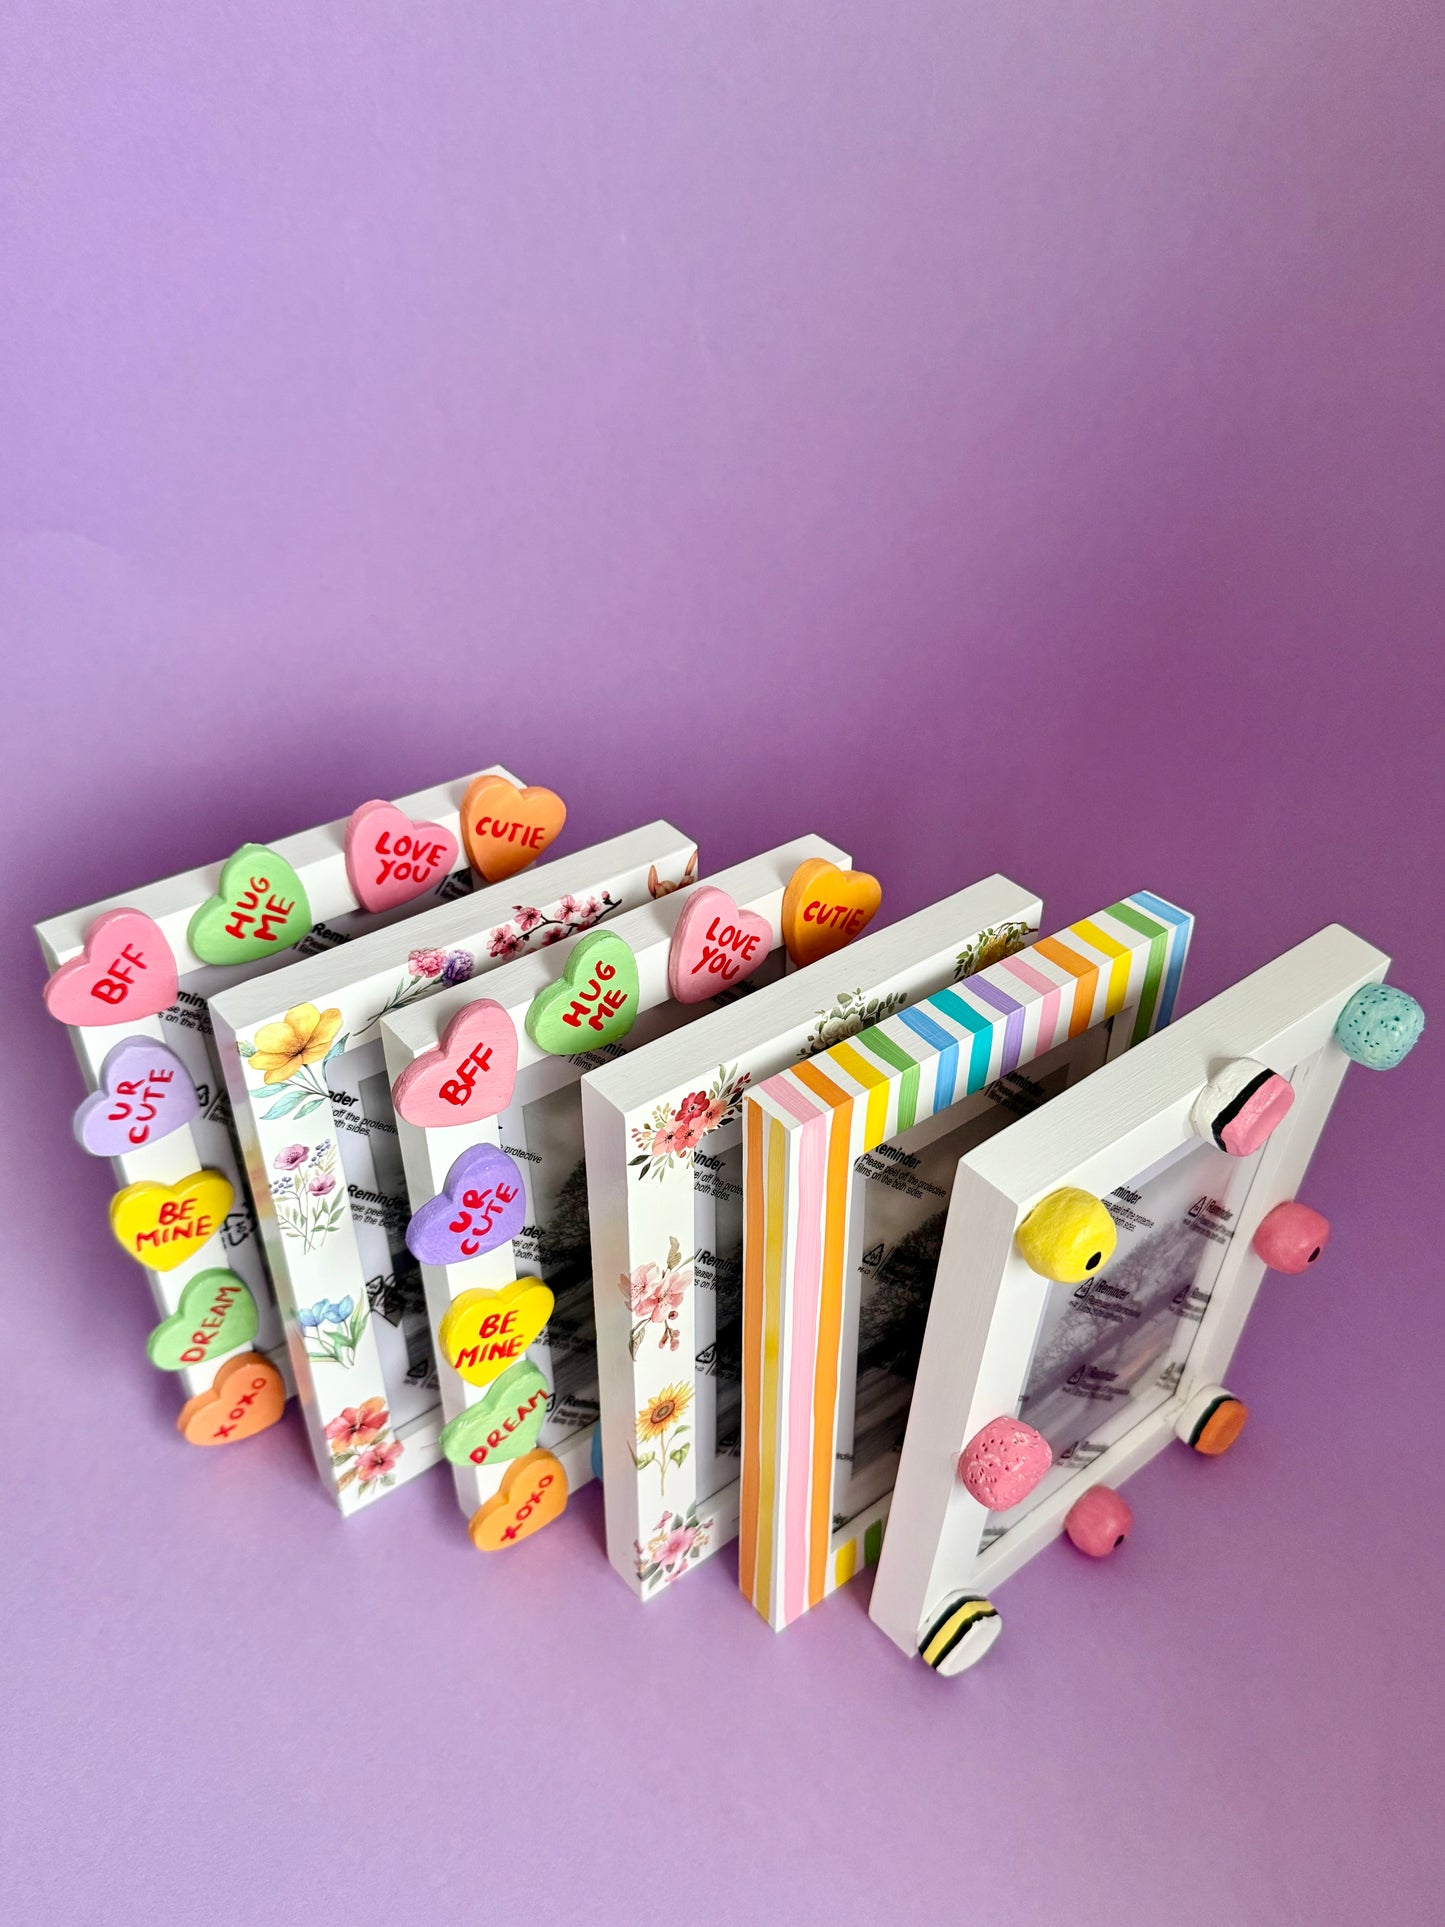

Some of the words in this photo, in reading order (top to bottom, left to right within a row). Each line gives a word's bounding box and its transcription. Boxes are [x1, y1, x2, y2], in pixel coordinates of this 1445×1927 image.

[375, 831, 448, 868] LOVE
[476, 817, 546, 850] CUTIE
[376, 858, 431, 886] YOU
[225, 875, 270, 939] HUG
[253, 894, 296, 941] ME
[803, 901, 866, 935] CUTIE
[706, 917, 761, 962] LOVE
[90, 943, 147, 1005] BFF
[691, 946, 740, 980] YOU
[562, 961, 616, 1028] HUG
[589, 990, 628, 1031] ME
[438, 1043, 493, 1106] BFF
[108, 1079, 146, 1121] UR
[128, 1069, 174, 1144] CUTE
[346, 1112, 360, 1123] the
[503, 1145, 543, 1164] protective
[861, 1153, 886, 1171] Please
[159, 1198, 199, 1226] BE
[449, 1189, 492, 1233] UR
[461, 1182, 519, 1255] CUTE
[136, 1214, 213, 1252] MINE
[179, 1286, 242, 1364] DREAM
[479, 1309, 520, 1339] BE
[454, 1334, 526, 1369] MINE
[213, 1377, 267, 1438] XOXO
[469, 1388, 548, 1464] DREAM
[500, 1474, 554, 1541] XOXO
